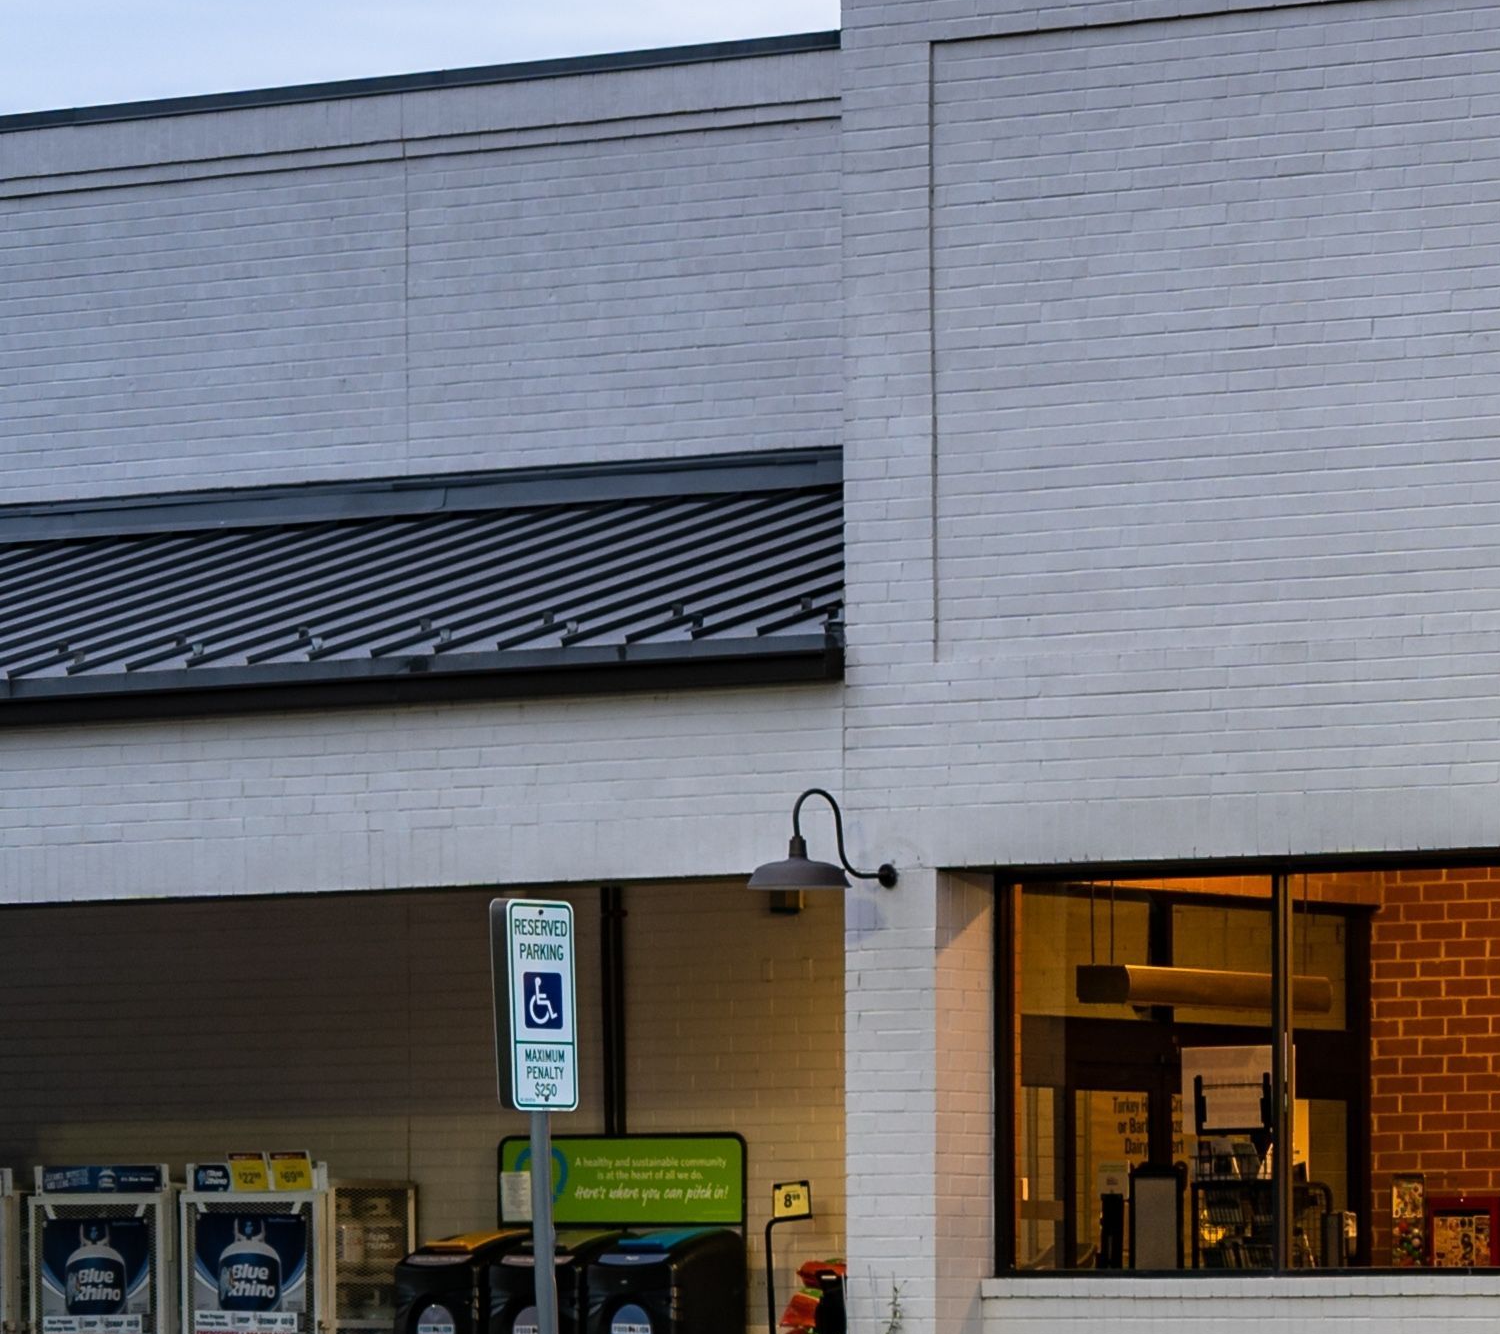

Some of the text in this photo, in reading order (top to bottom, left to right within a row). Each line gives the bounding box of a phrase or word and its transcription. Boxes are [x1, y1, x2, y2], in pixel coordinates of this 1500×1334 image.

[514, 919, 567, 937] RESERVED
[519, 943, 564, 961] PARKING
[525, 1048, 565, 1063] MAXIMUM
[526, 1066, 564, 1080] PENALTY
[534, 1083, 557, 1097] $250
[575, 1157, 726, 1169] A healthy and sustainable community
[616, 1170, 628, 1180] the
[630, 1170, 653, 1180] heart
[654, 1170, 664, 1180] of
[665, 1170, 675, 1180] all
[676, 1172, 690, 1180] we
[574, 1183, 729, 1206] Here's where you can pitch in!
[78, 1268, 114, 1284] Blue
[232, 1264, 268, 1280] Blue
[75, 1284, 121, 1301] Rhino
[228, 1279, 275, 1299] Rhino
